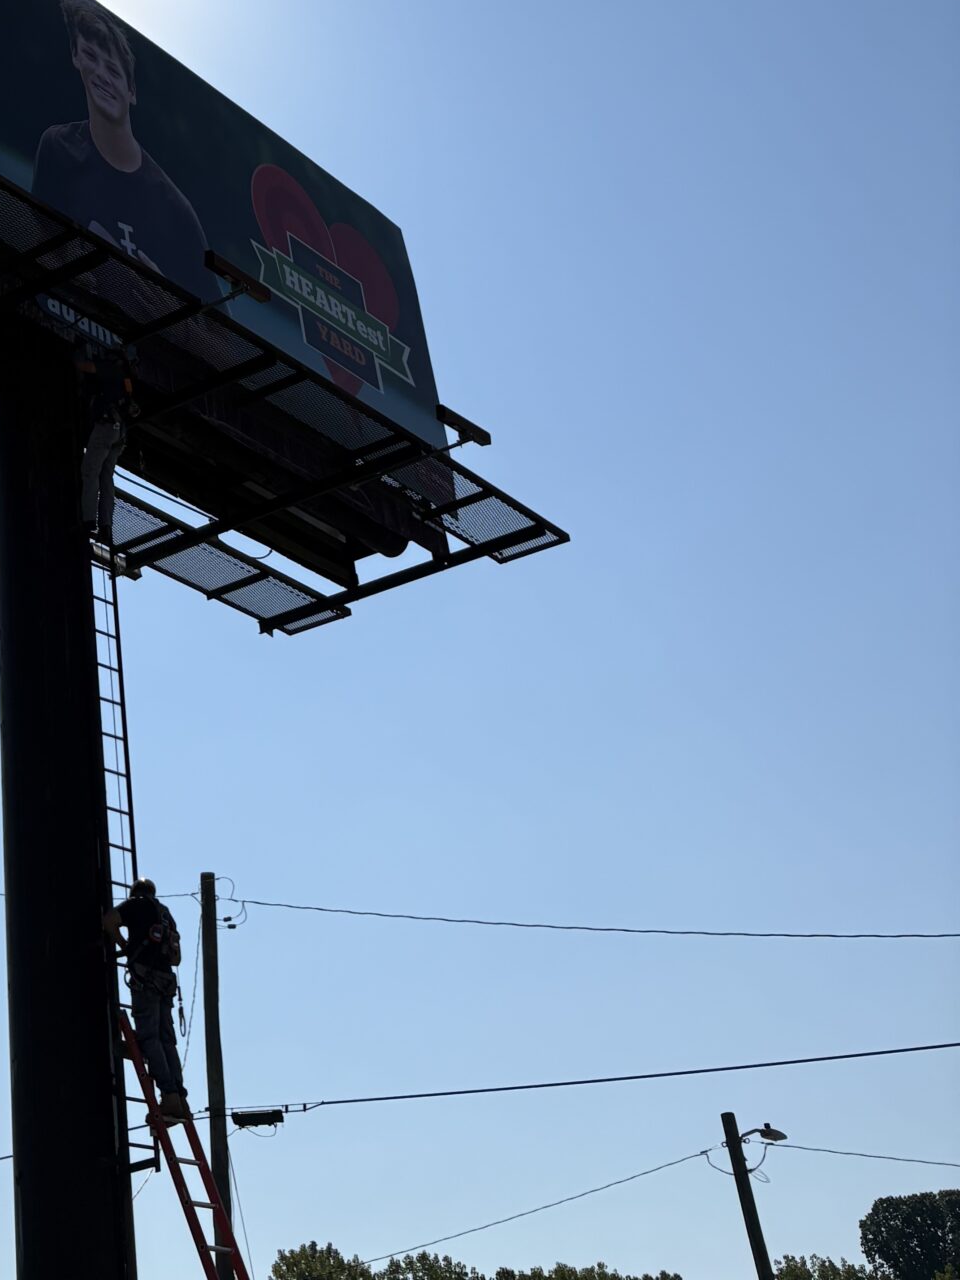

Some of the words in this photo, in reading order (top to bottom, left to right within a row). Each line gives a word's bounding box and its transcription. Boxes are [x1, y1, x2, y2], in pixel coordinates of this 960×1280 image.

[315, 263, 343, 290] THE
[282, 264, 386, 352] HEARTest
[316, 320, 367, 366] YARD
